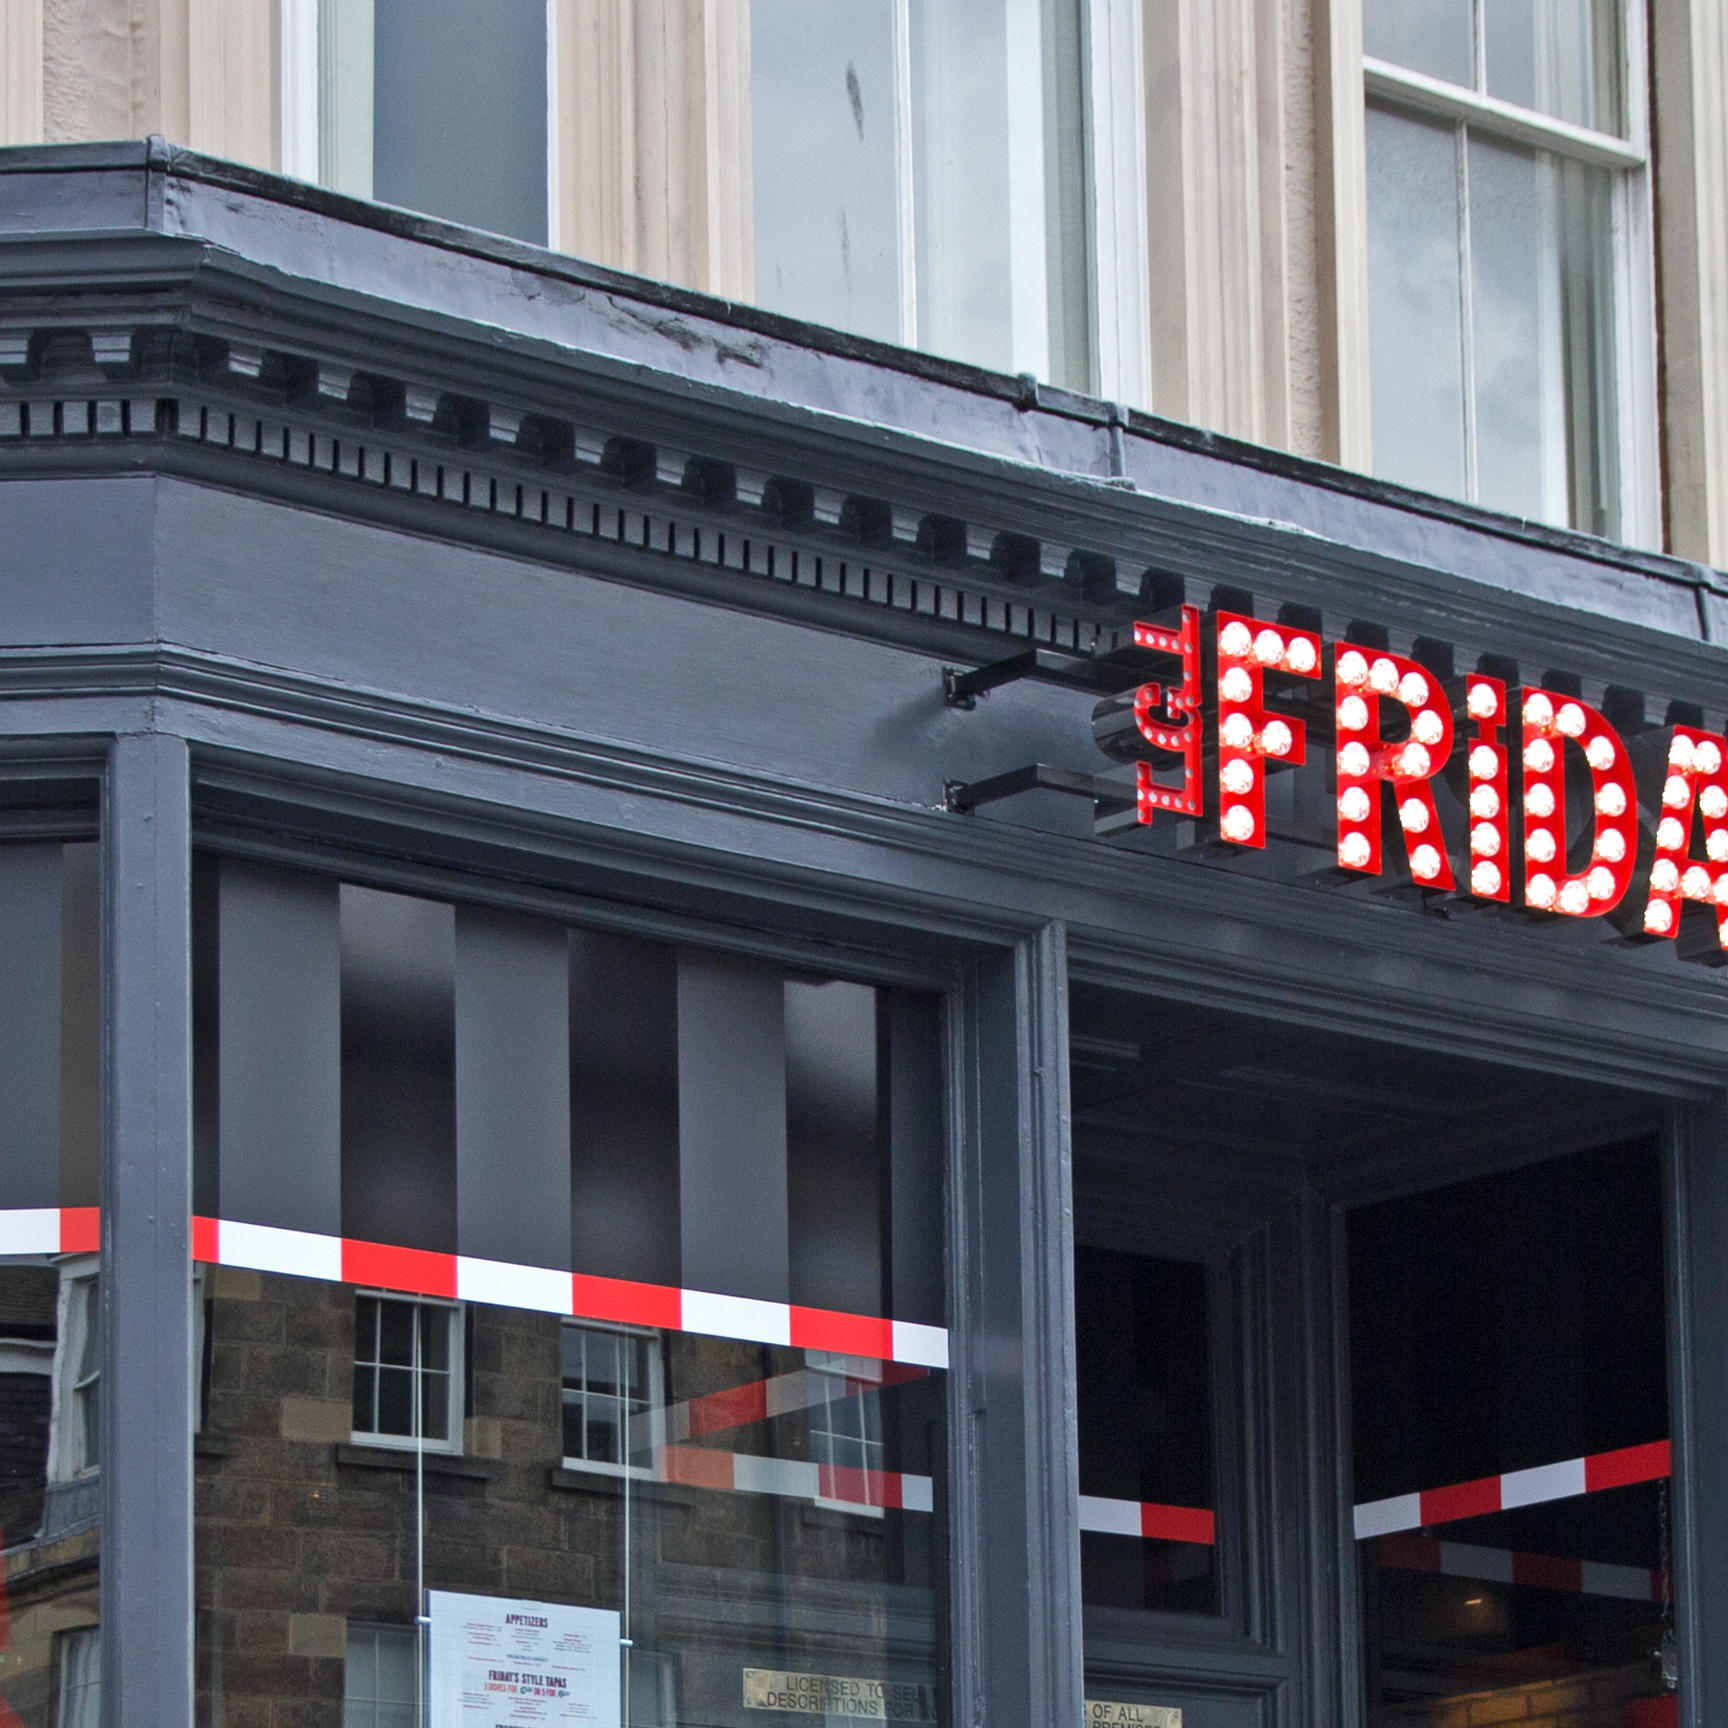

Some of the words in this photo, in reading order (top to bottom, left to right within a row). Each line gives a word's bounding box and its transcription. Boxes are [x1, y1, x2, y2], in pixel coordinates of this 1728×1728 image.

[505, 1613, 548, 1628] APPETIZERS
[522, 1673, 543, 1686] STYLE
[546, 1676, 567, 1688] TAPAS
[785, 1676, 860, 1696] LICENSED
[866, 1682, 884, 1699] TO
[766, 1692, 878, 1716] DESCRIPTIONS
[1092, 1704, 1112, 1718] OF
[1118, 1706, 1144, 1722] ALL
